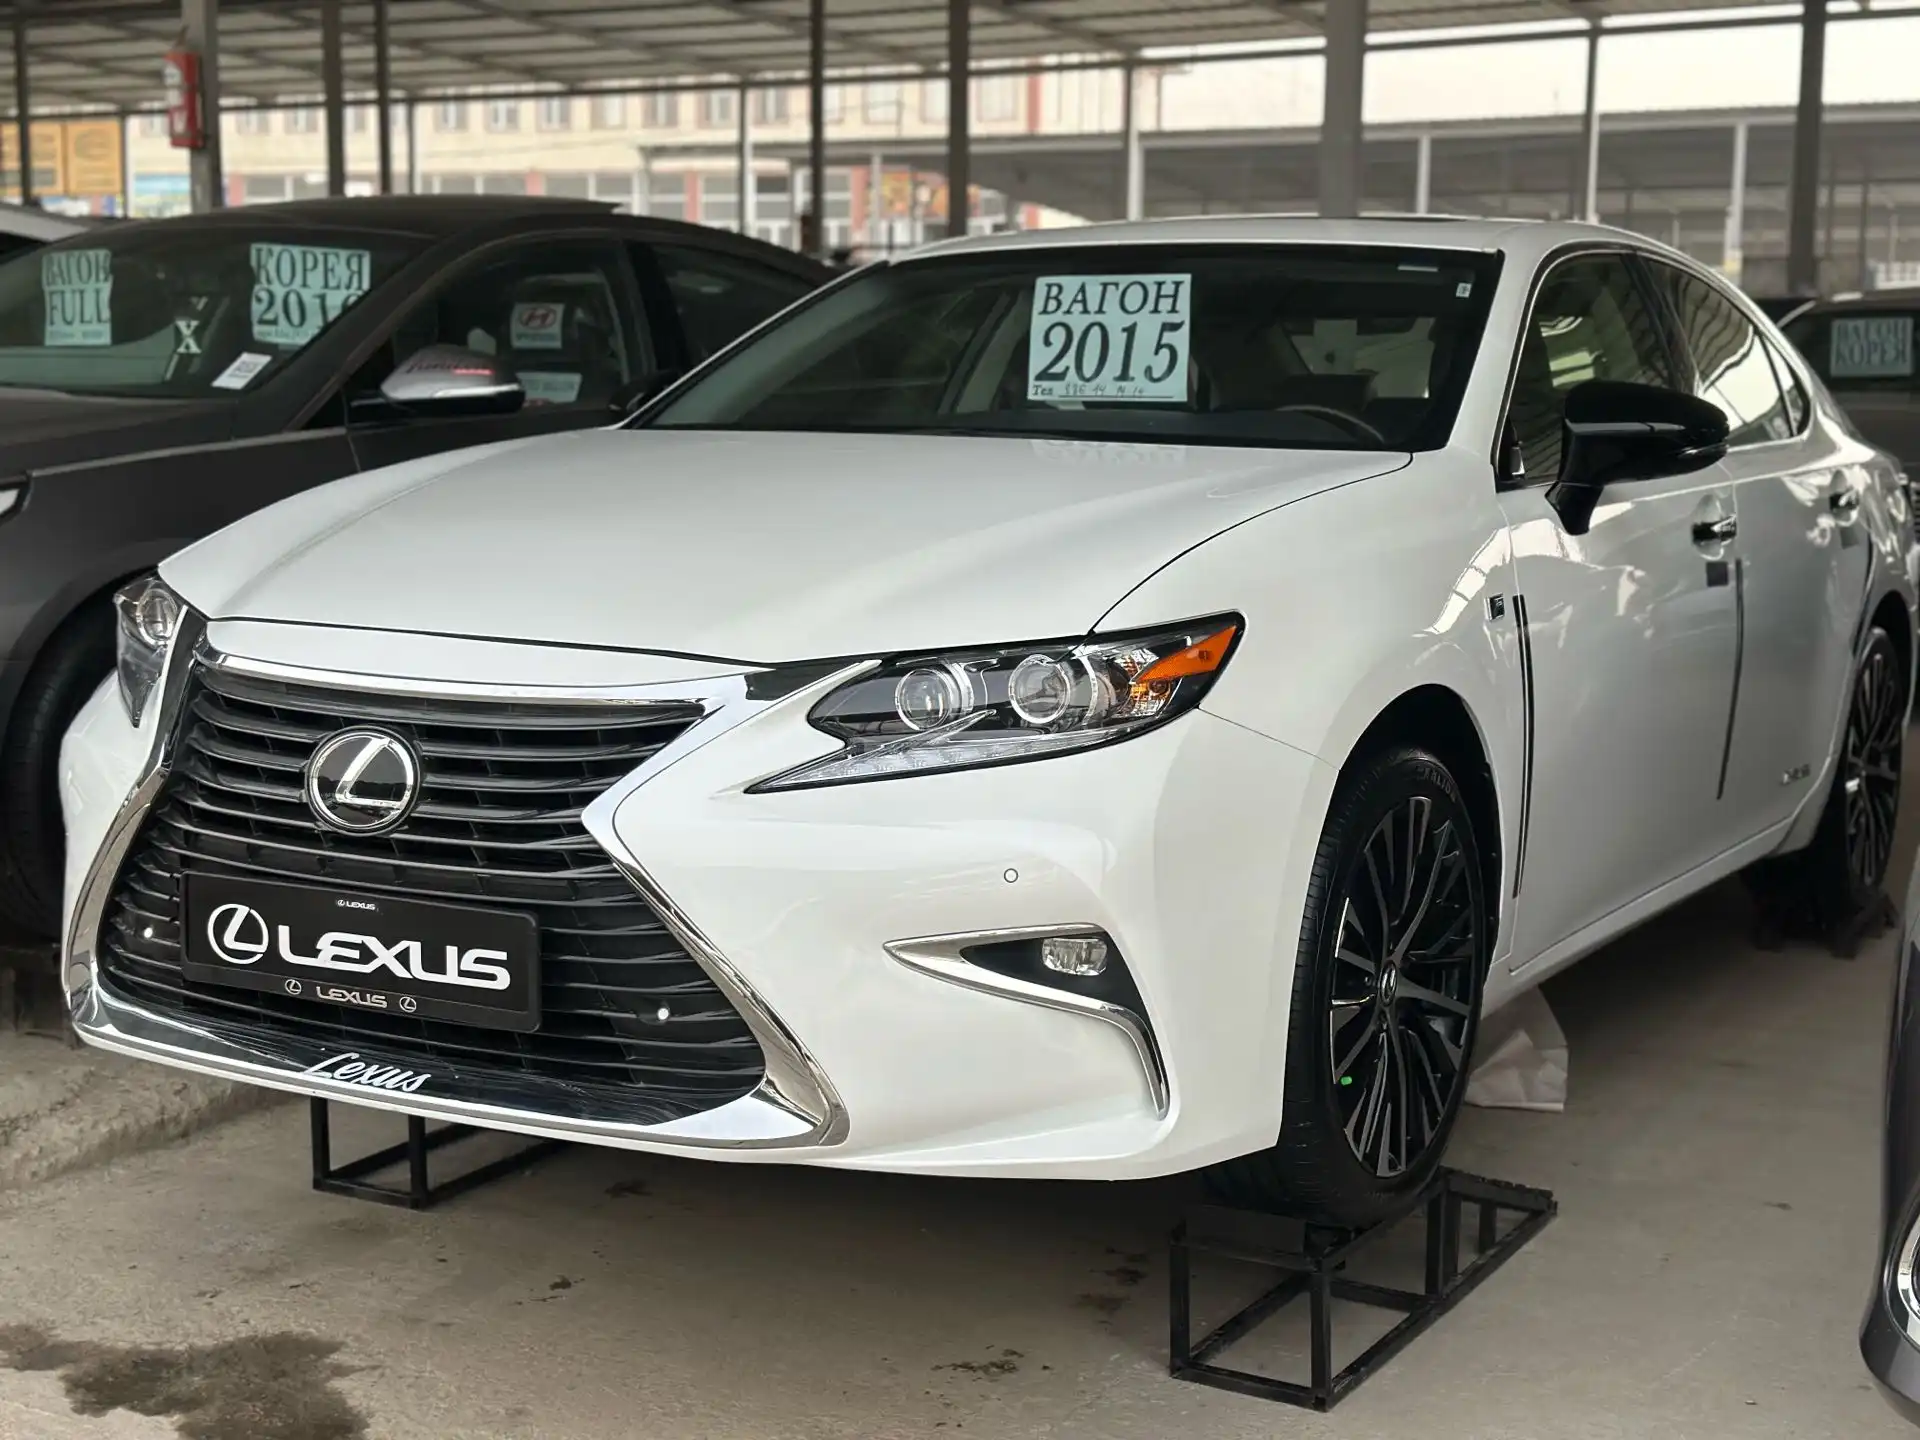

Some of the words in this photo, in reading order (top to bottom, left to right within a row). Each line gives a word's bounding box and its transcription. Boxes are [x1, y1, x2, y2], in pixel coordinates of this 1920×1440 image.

[254, 247, 366, 291] КОРЕЯ
[47, 287, 110, 326] FULL
[1037, 280, 1185, 316] ВАГОН
[1033, 320, 1186, 384] 2015
[346, 900, 376, 911] LEXUS
[278, 924, 511, 990] LEXUS
[316, 986, 388, 1008] LEXUS
[302, 1052, 432, 1092] Lexus
